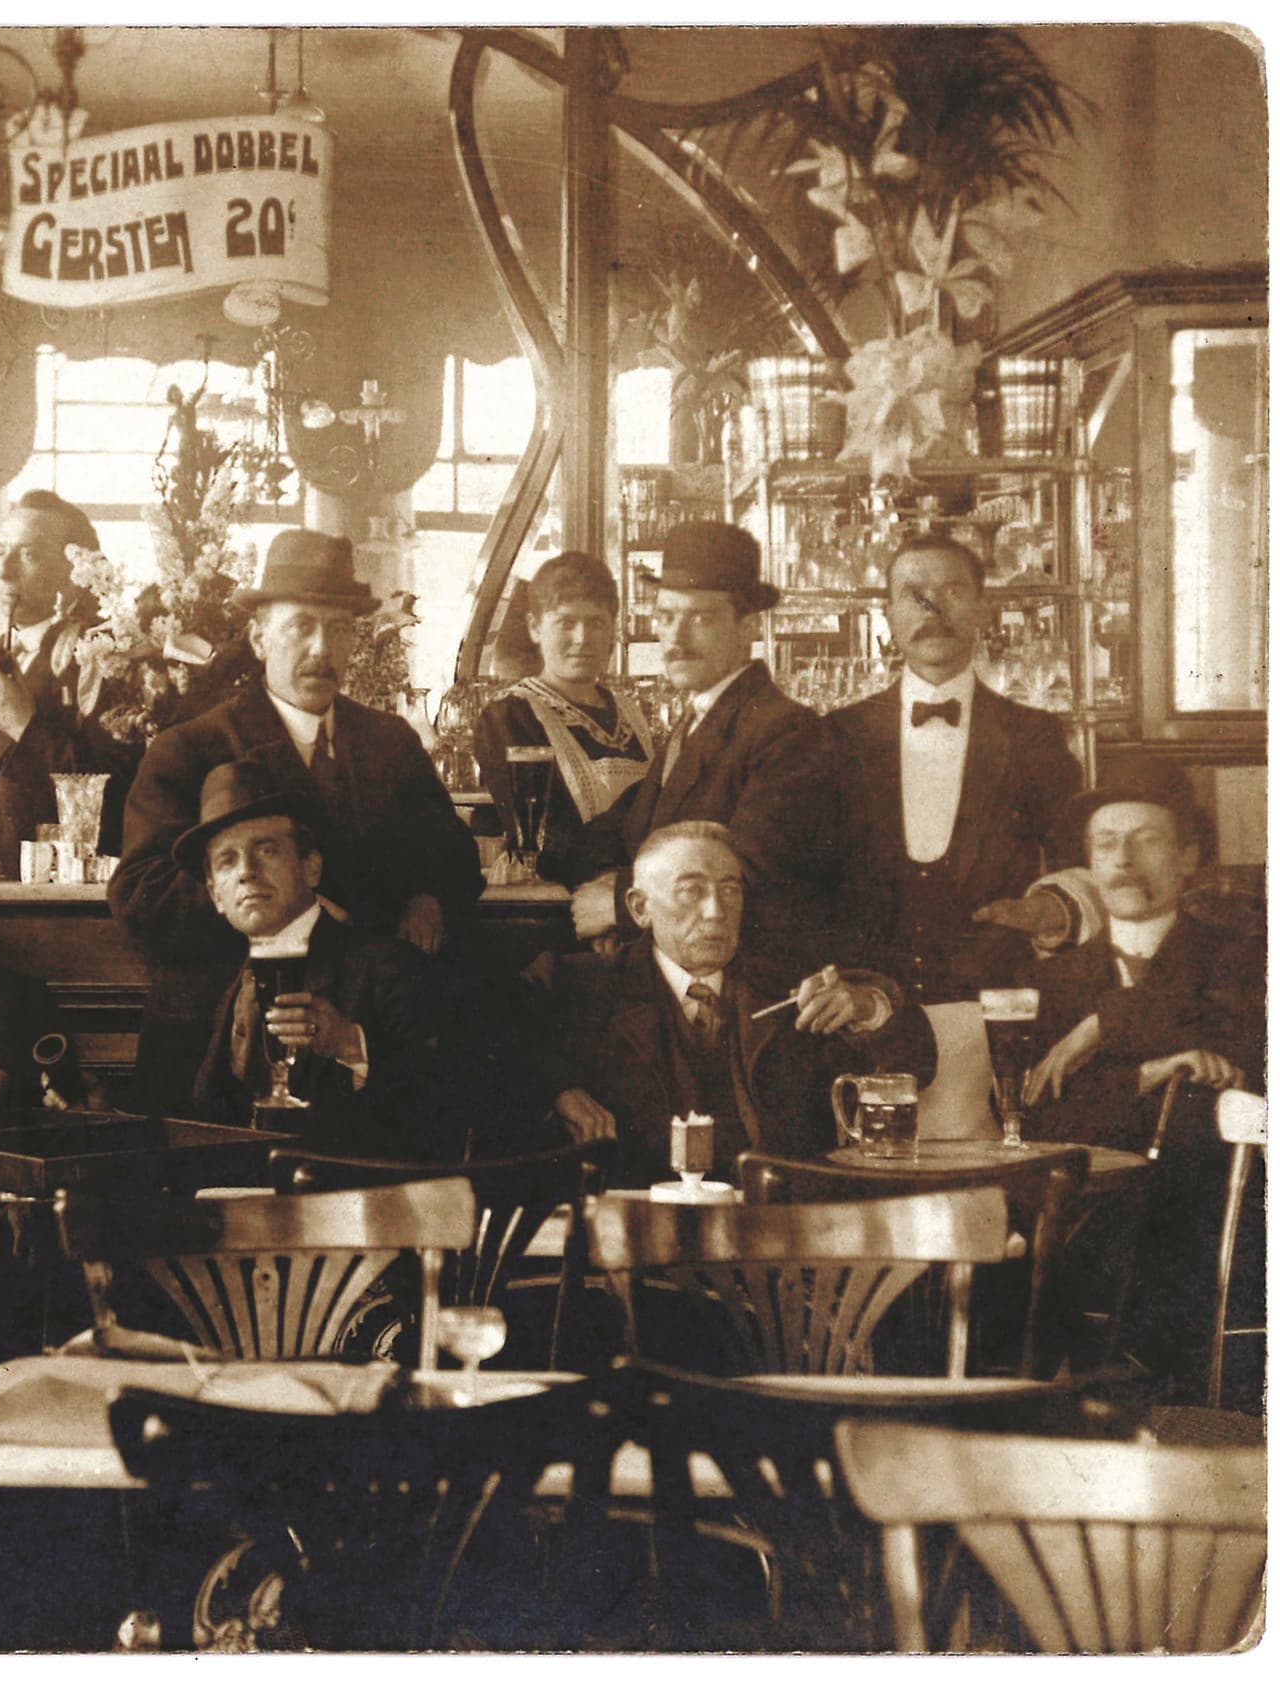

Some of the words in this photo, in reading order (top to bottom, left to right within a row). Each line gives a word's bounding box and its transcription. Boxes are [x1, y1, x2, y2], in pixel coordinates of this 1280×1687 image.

[20, 138, 184, 204] SPECIAAL
[193, 130, 319, 178] DOBBEL
[21, 211, 193, 281] GERSTEN
